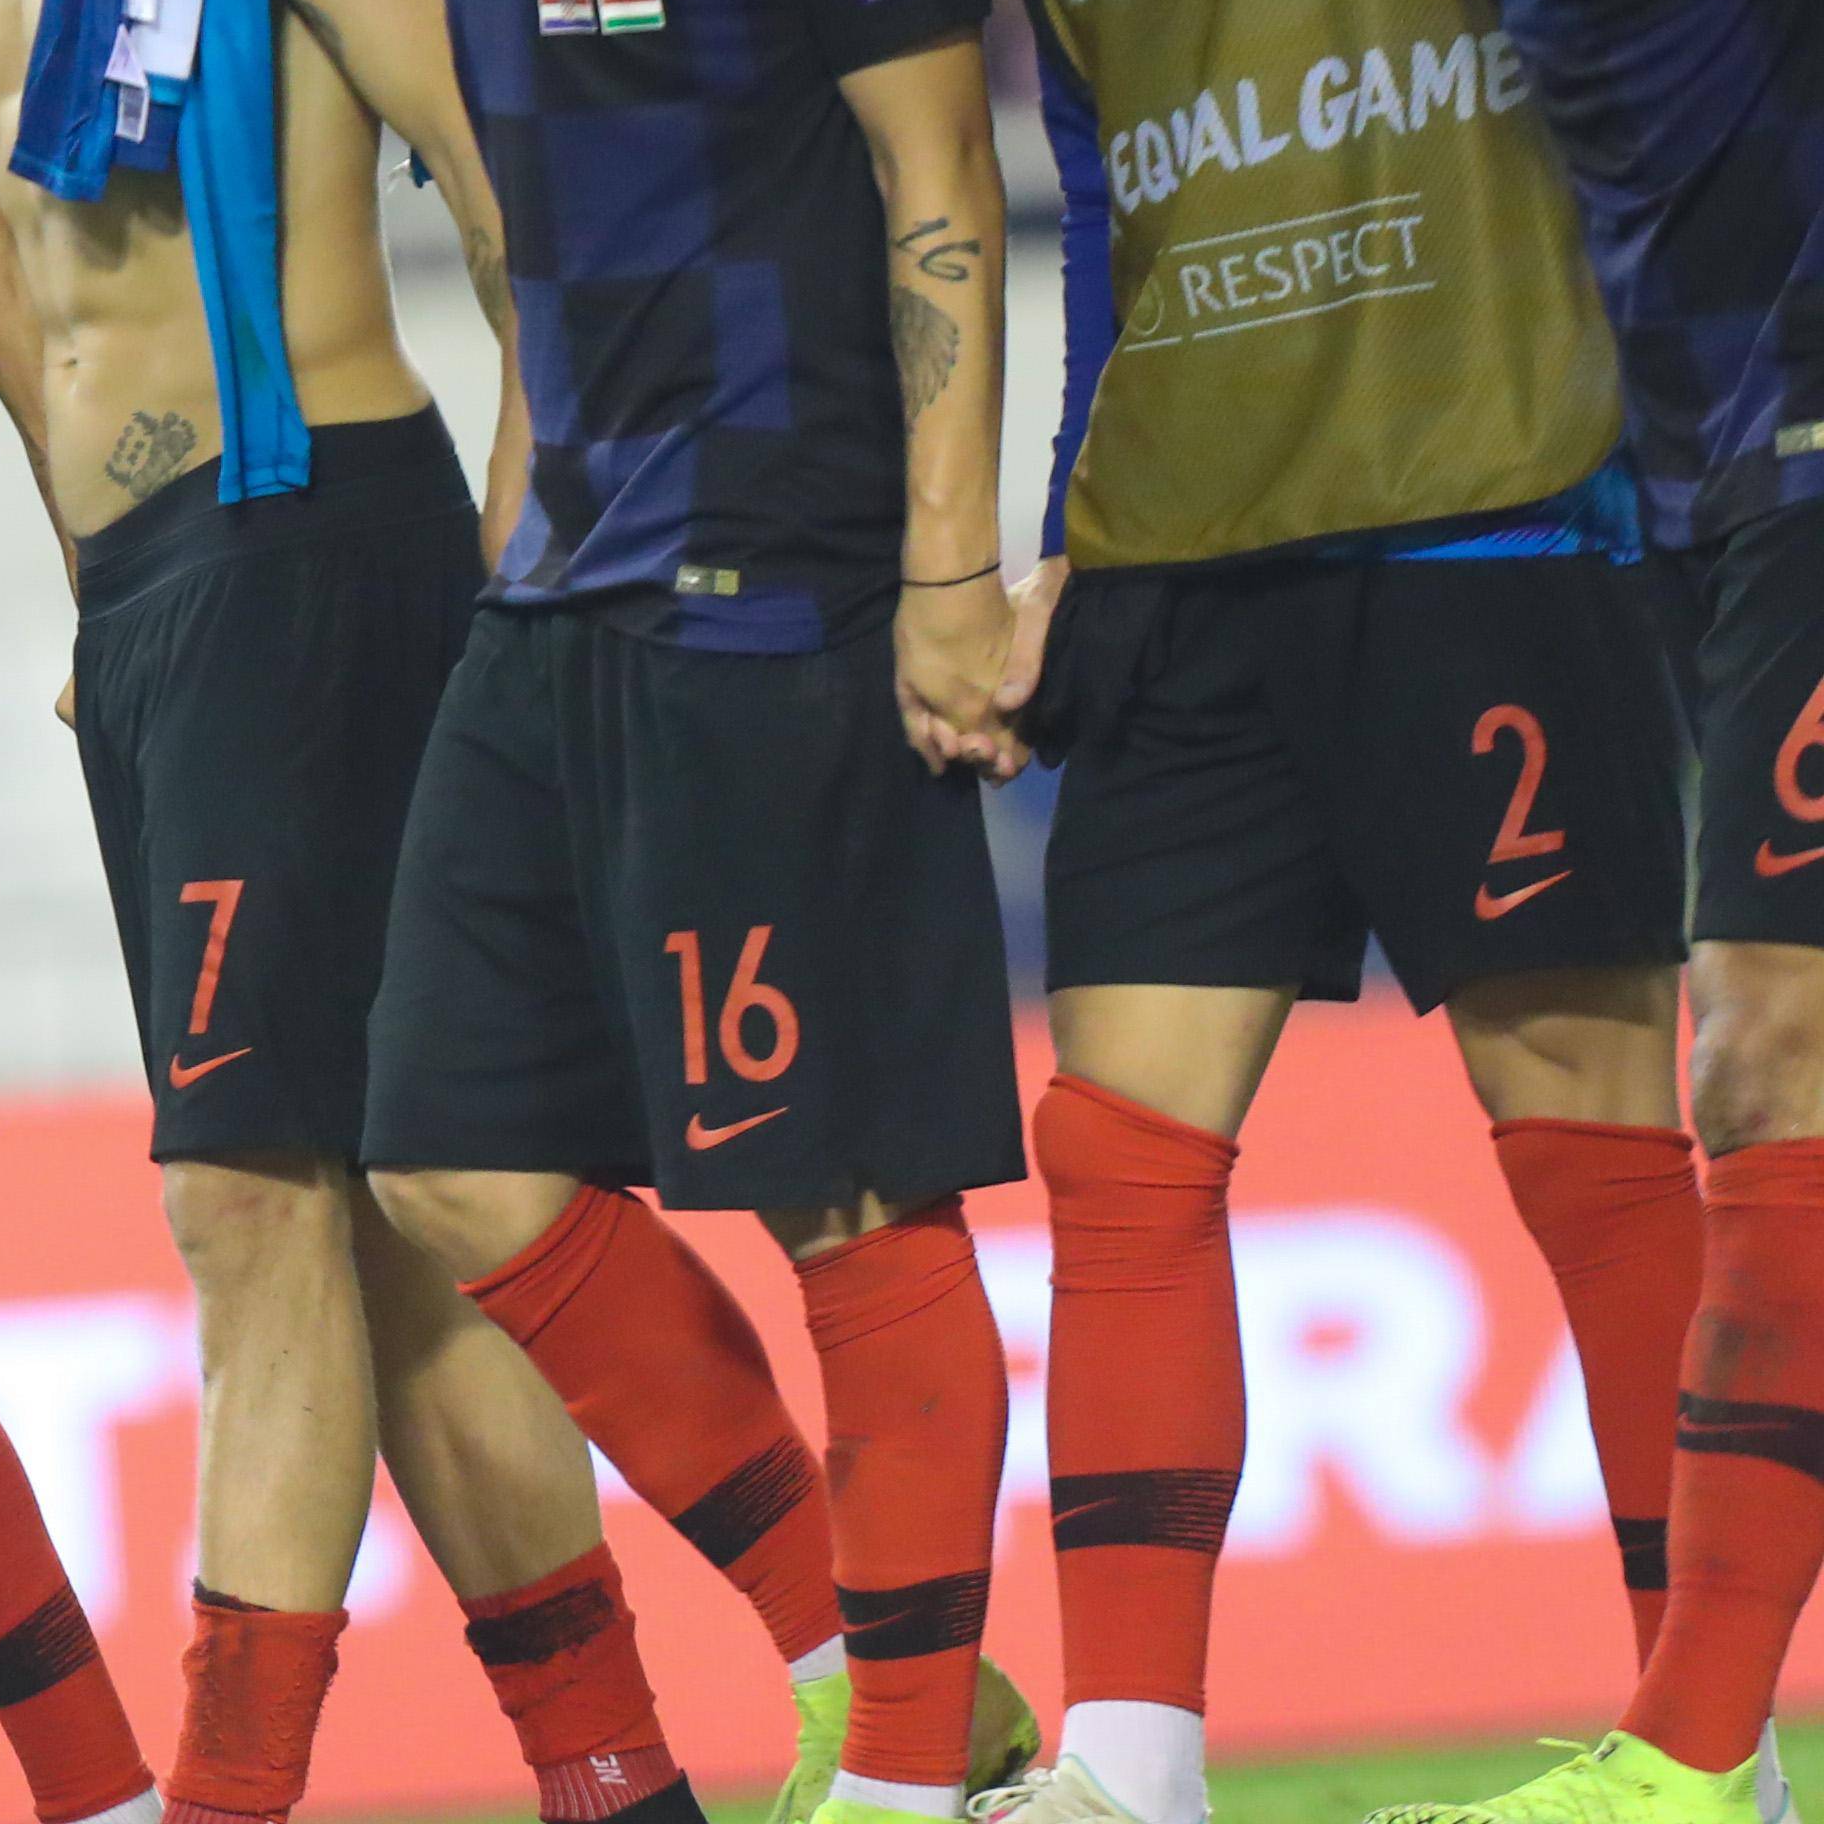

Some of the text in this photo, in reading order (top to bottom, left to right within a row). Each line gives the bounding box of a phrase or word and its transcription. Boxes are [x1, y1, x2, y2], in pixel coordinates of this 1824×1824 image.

[1297, 30, 1532, 153] GAME
[1180, 215, 1423, 318] RESPECT
[1471, 705, 1565, 863] 2
[178, 878, 246, 1035] 7
[663, 924, 801, 1086] 16
